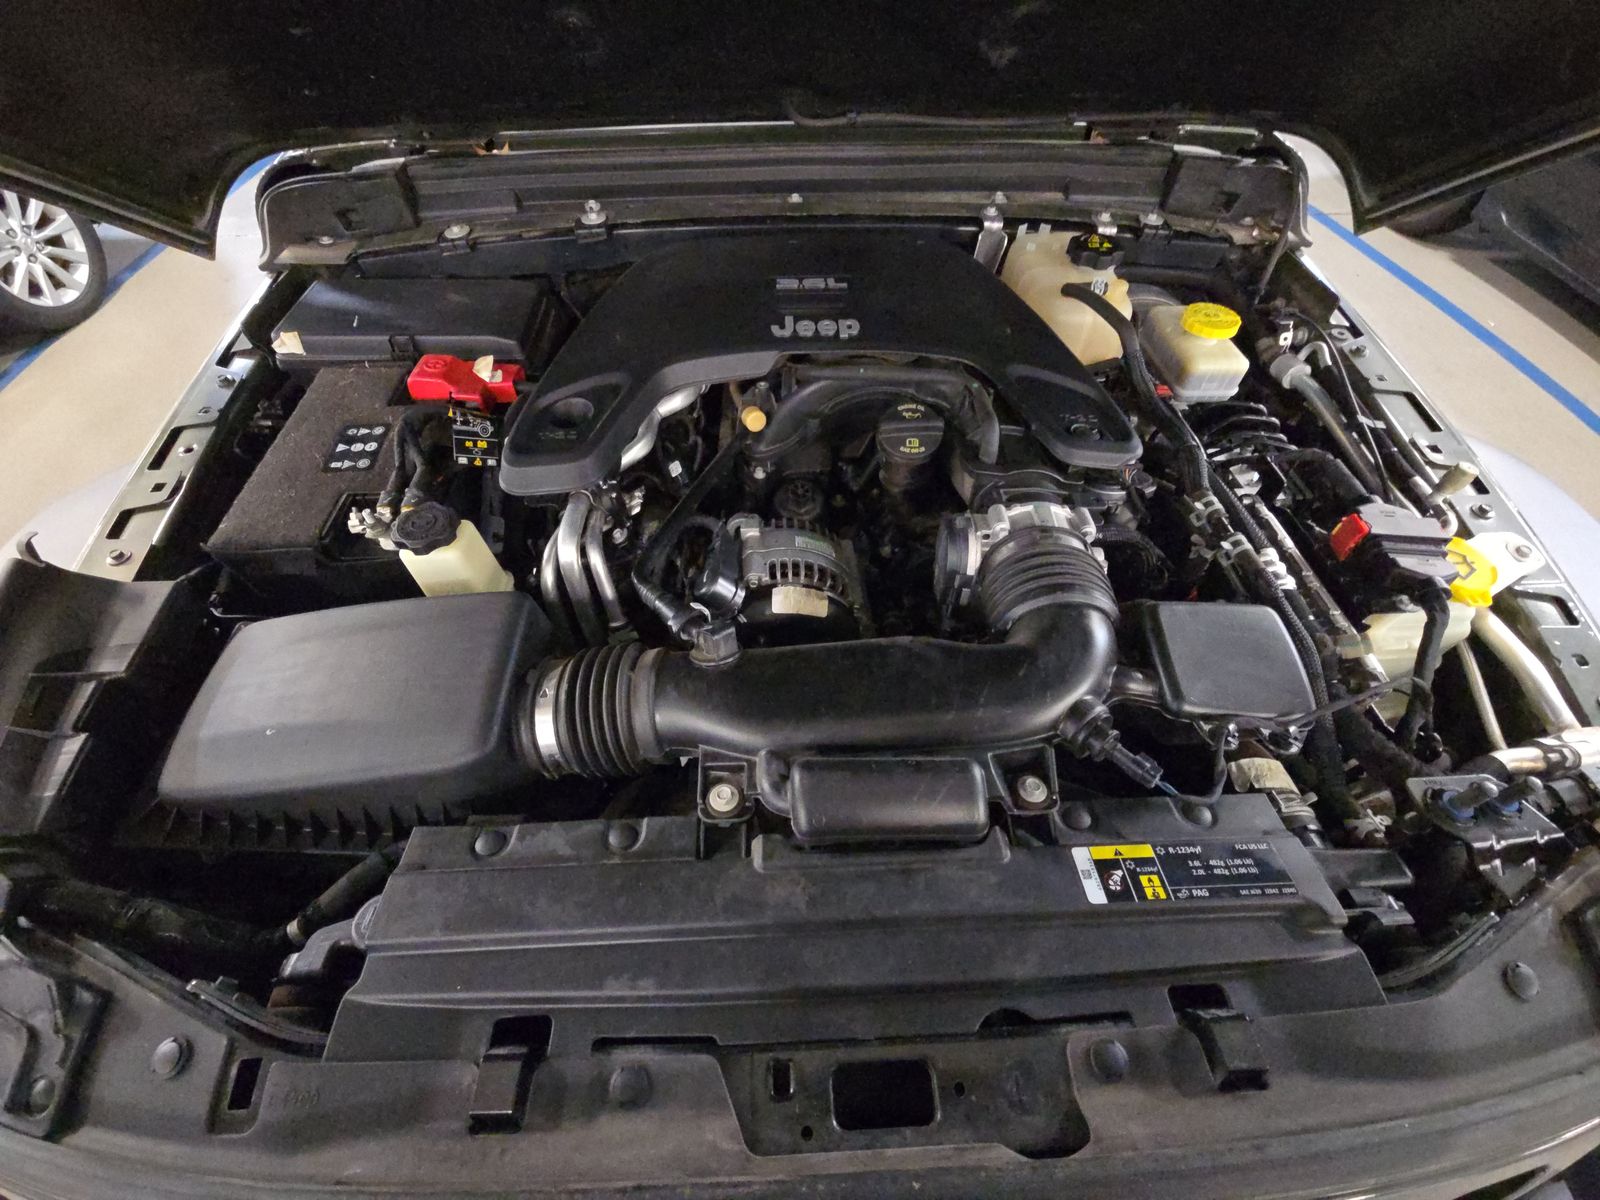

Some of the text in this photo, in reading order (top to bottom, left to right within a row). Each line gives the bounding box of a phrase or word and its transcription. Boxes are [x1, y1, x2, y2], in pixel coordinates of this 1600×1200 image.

[770, 315, 860, 340] Jeep
[1168, 845, 1202, 855] R-1234yf
[1191, 888, 1210, 898] PAG
